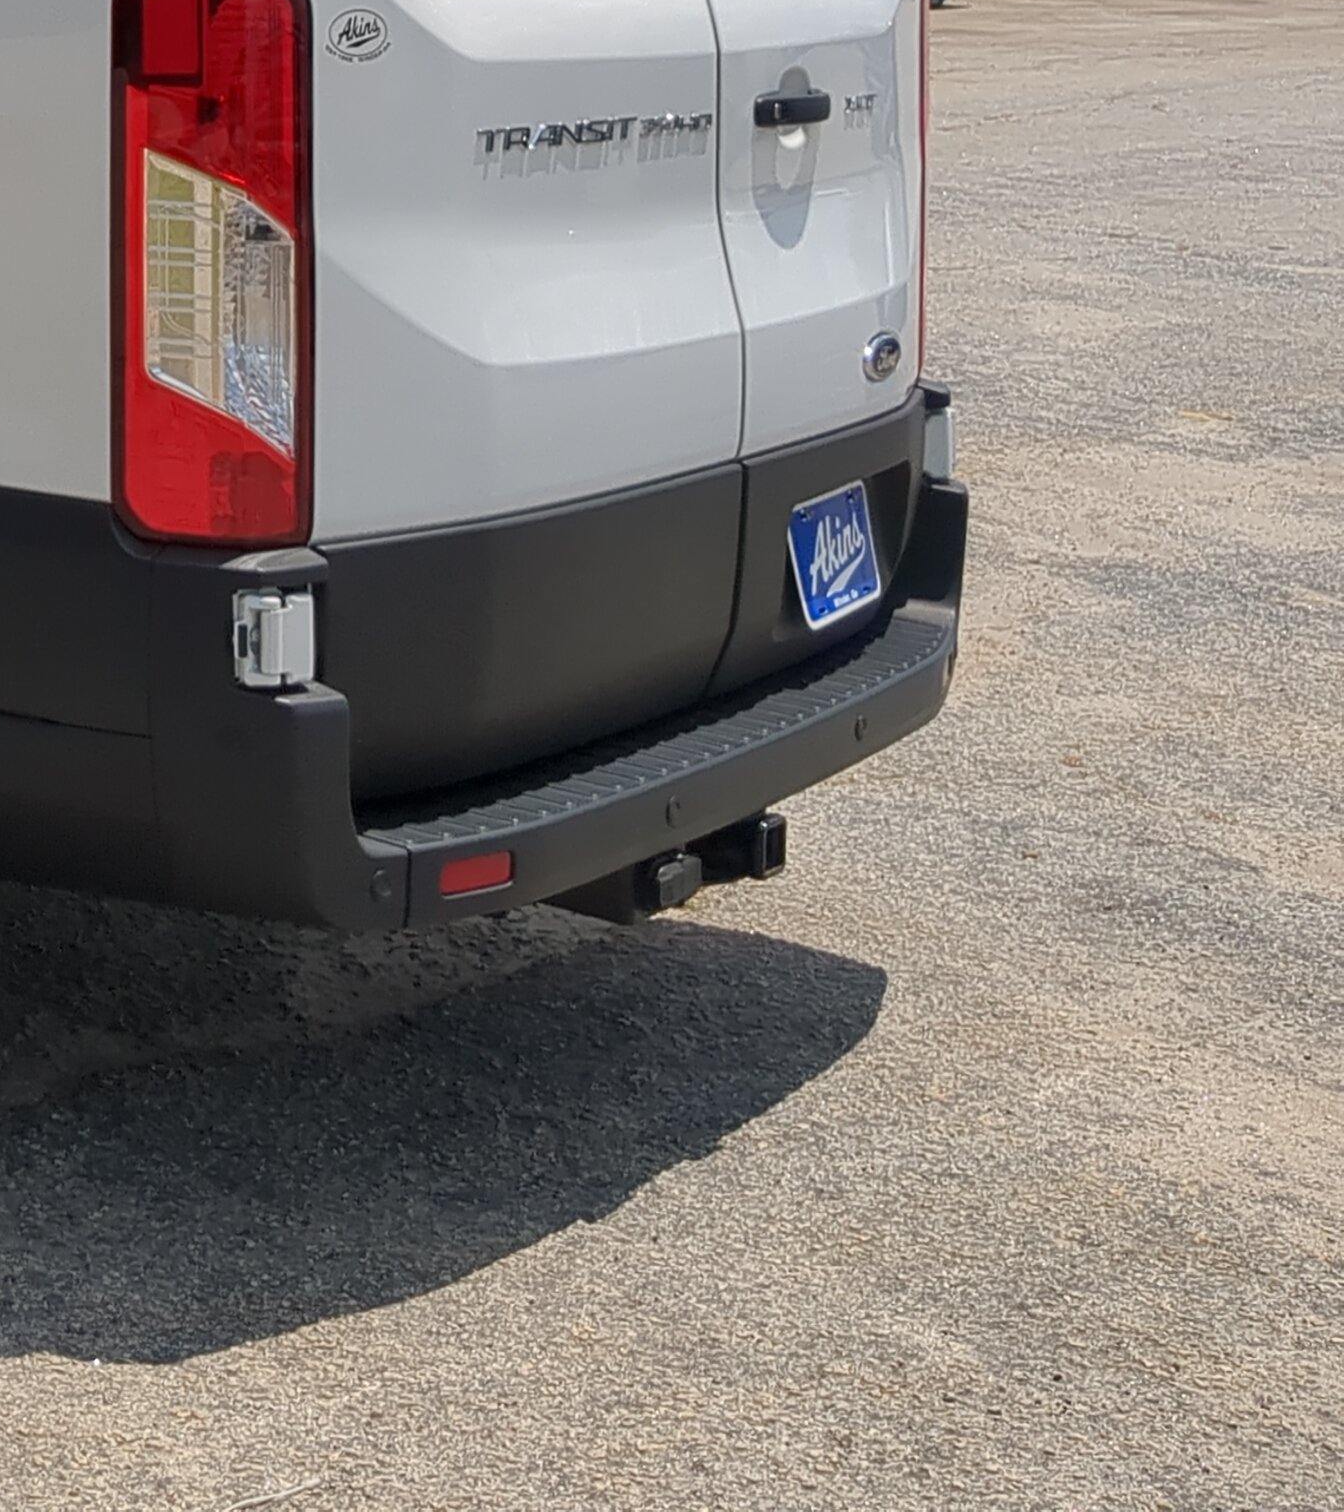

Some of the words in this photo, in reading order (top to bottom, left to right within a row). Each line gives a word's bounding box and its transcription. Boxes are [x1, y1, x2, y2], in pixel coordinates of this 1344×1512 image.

[336, 14, 381, 49] Akins
[475, 115, 638, 154] TRANSIT
[809, 510, 866, 597] Akins
